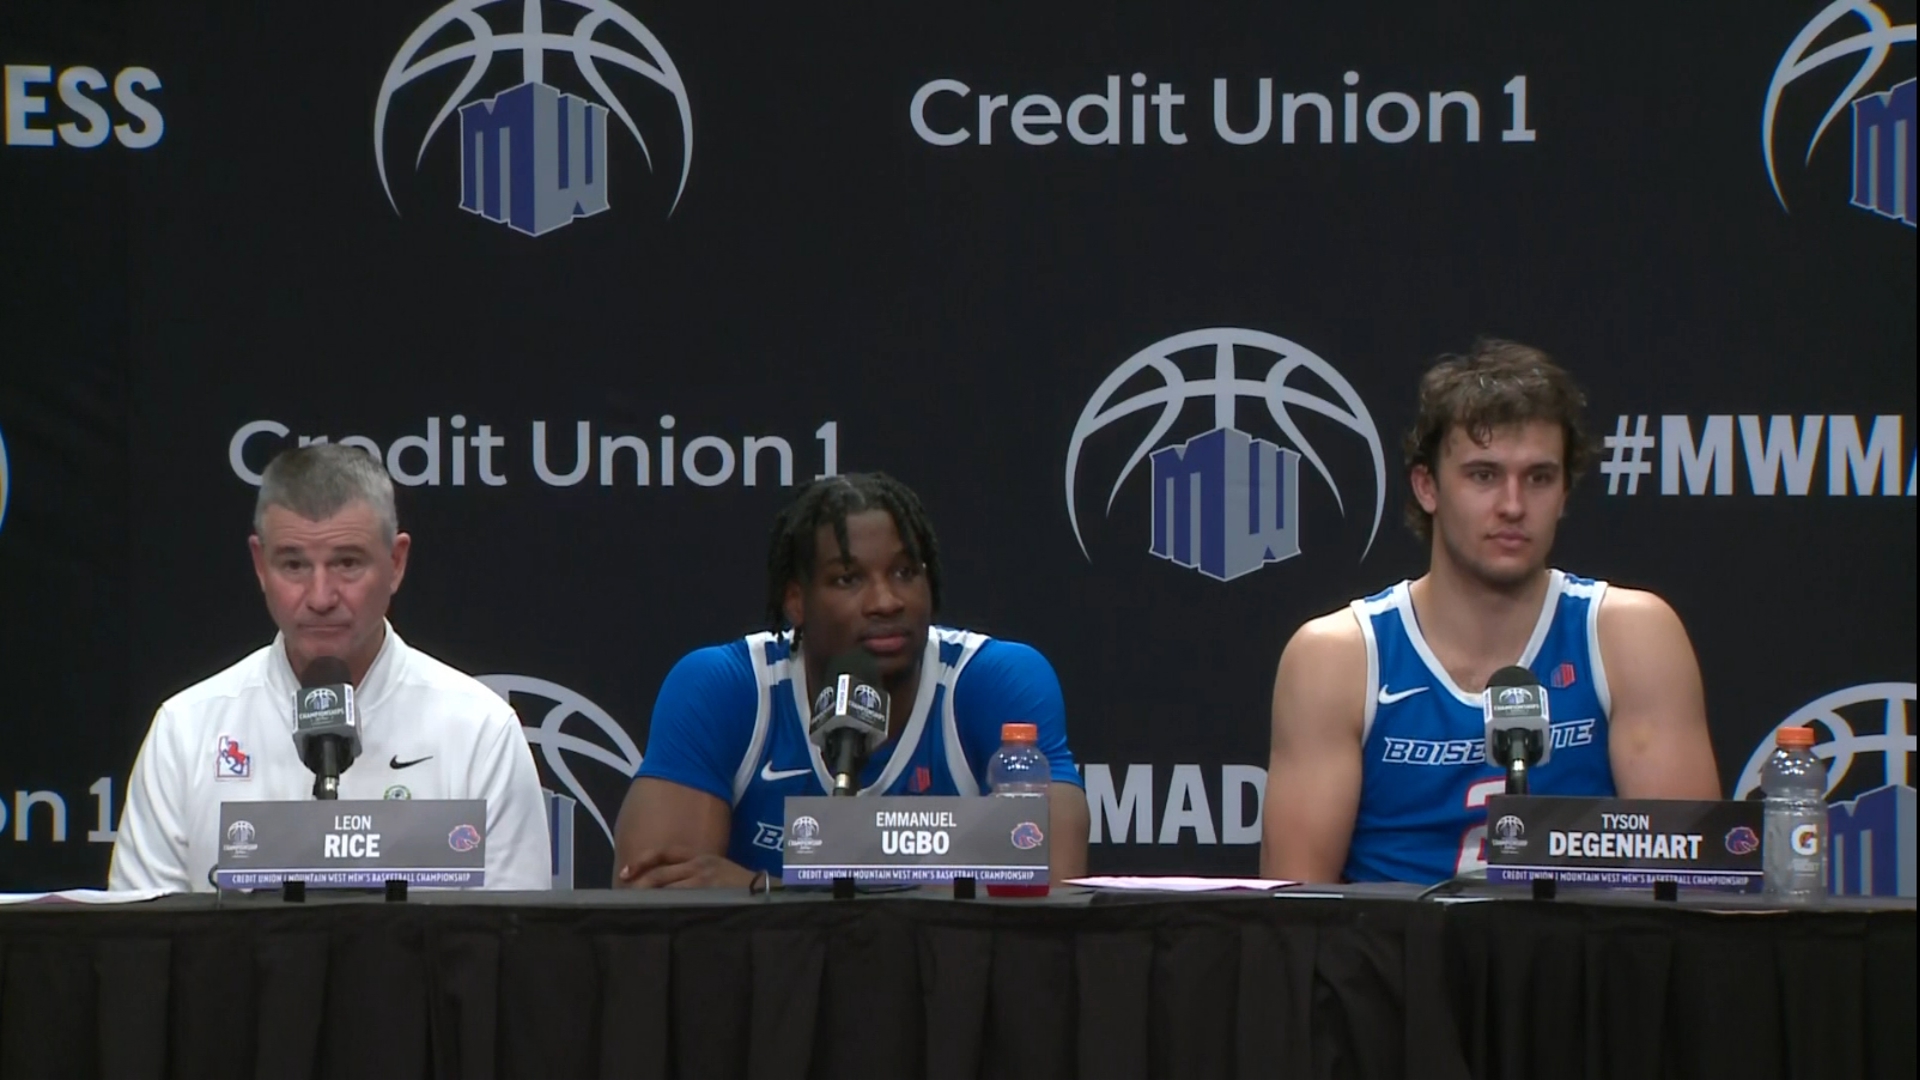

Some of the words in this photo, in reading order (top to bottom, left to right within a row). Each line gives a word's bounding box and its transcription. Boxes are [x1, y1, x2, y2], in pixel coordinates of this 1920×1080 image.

[5, 65, 164, 149] ESS
[910, 73, 1187, 146] Credit
[1213, 71, 1480, 145] Union
[1501, 76, 1536, 142] 1
[229, 415, 507, 487] Cdit
[532, 415, 793, 486] Union
[814, 421, 846, 481] 1
[1600, 414, 1917, 496] #MWM
[0, 790, 66, 841] n
[87, 776, 118, 842] 1
[1074, 763, 1268, 844] MAD
[334, 814, 372, 831] LEON
[876, 811, 957, 828] EMMANUEL
[1601, 813, 1650, 831] TYSON
[324, 833, 381, 859] RICE
[881, 830, 951, 855] UGBO
[1549, 831, 1703, 860] DEGENHART
[1791, 824, 1818, 856] G
[232, 874, 256, 884] CREDIT
[258, 874, 282, 884] UNION
[288, 873, 327, 883] MOUNTAIN
[328, 873, 347, 883] WEST
[348, 873, 371, 883] MEN'S
[416, 872, 471, 882] CHAMPIONSHIP
[798, 870, 821, 879] CREDIT
[823, 870, 847, 879] UNION
[853, 870, 891, 879] MOUNTAIN
[893, 870, 911, 879] WEST
[912, 870, 934, 879] MEN'S
[980, 870, 1035, 880] CHAMPIONSHIP
[1502, 870, 1527, 880] CREDIT
[1529, 871, 1554, 880] UNION
[1560, 872, 1600, 882] MOUNTAIN
[1601, 873, 1620, 883] WEST
[1621, 873, 1645, 883] MEN'S
[1692, 876, 1750, 886] CHAMPIONSHIP
